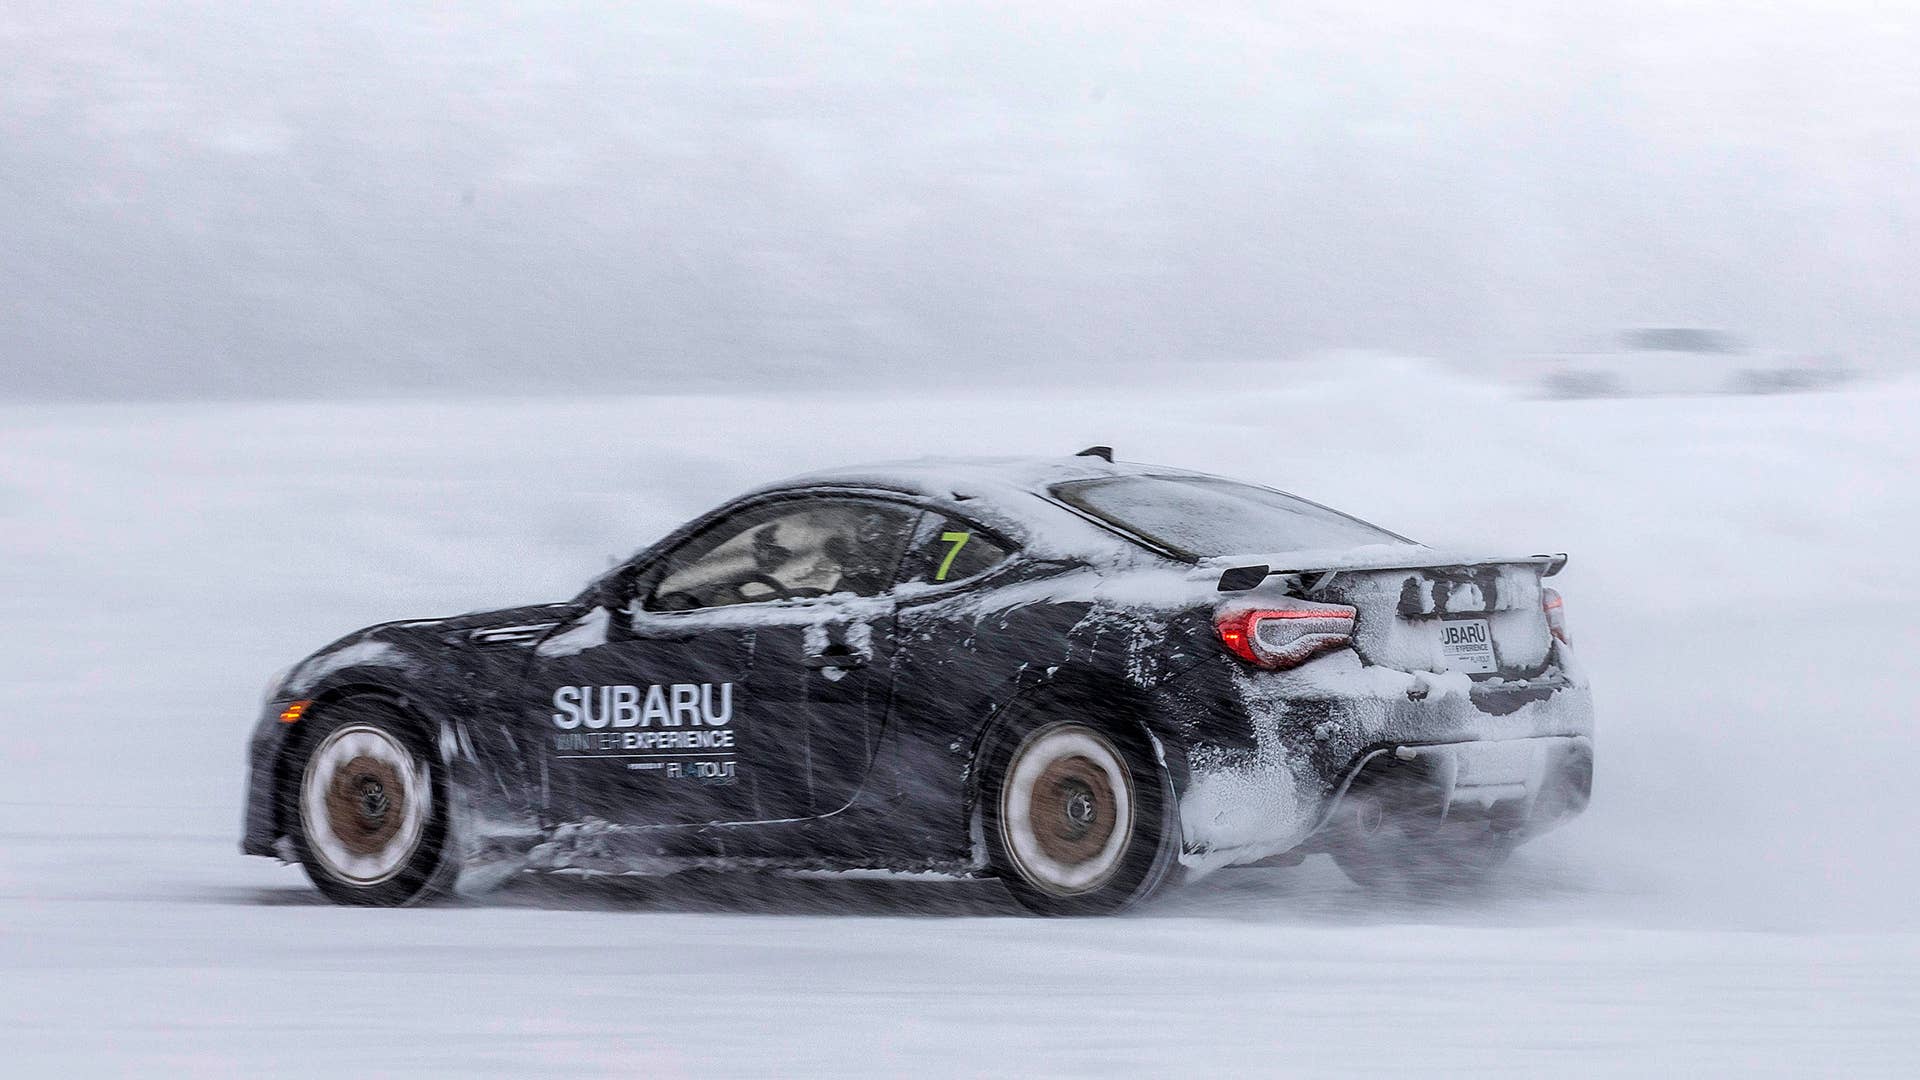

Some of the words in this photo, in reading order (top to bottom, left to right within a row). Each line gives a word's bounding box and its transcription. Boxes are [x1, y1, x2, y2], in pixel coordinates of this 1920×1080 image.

[935, 531, 970, 581] 7
[1441, 626, 1486, 645] UBARU
[1456, 644, 1488, 652] EXPERIENCE
[552, 683, 733, 729] SUBARU
[622, 730, 735, 749] EXPERIENCE
